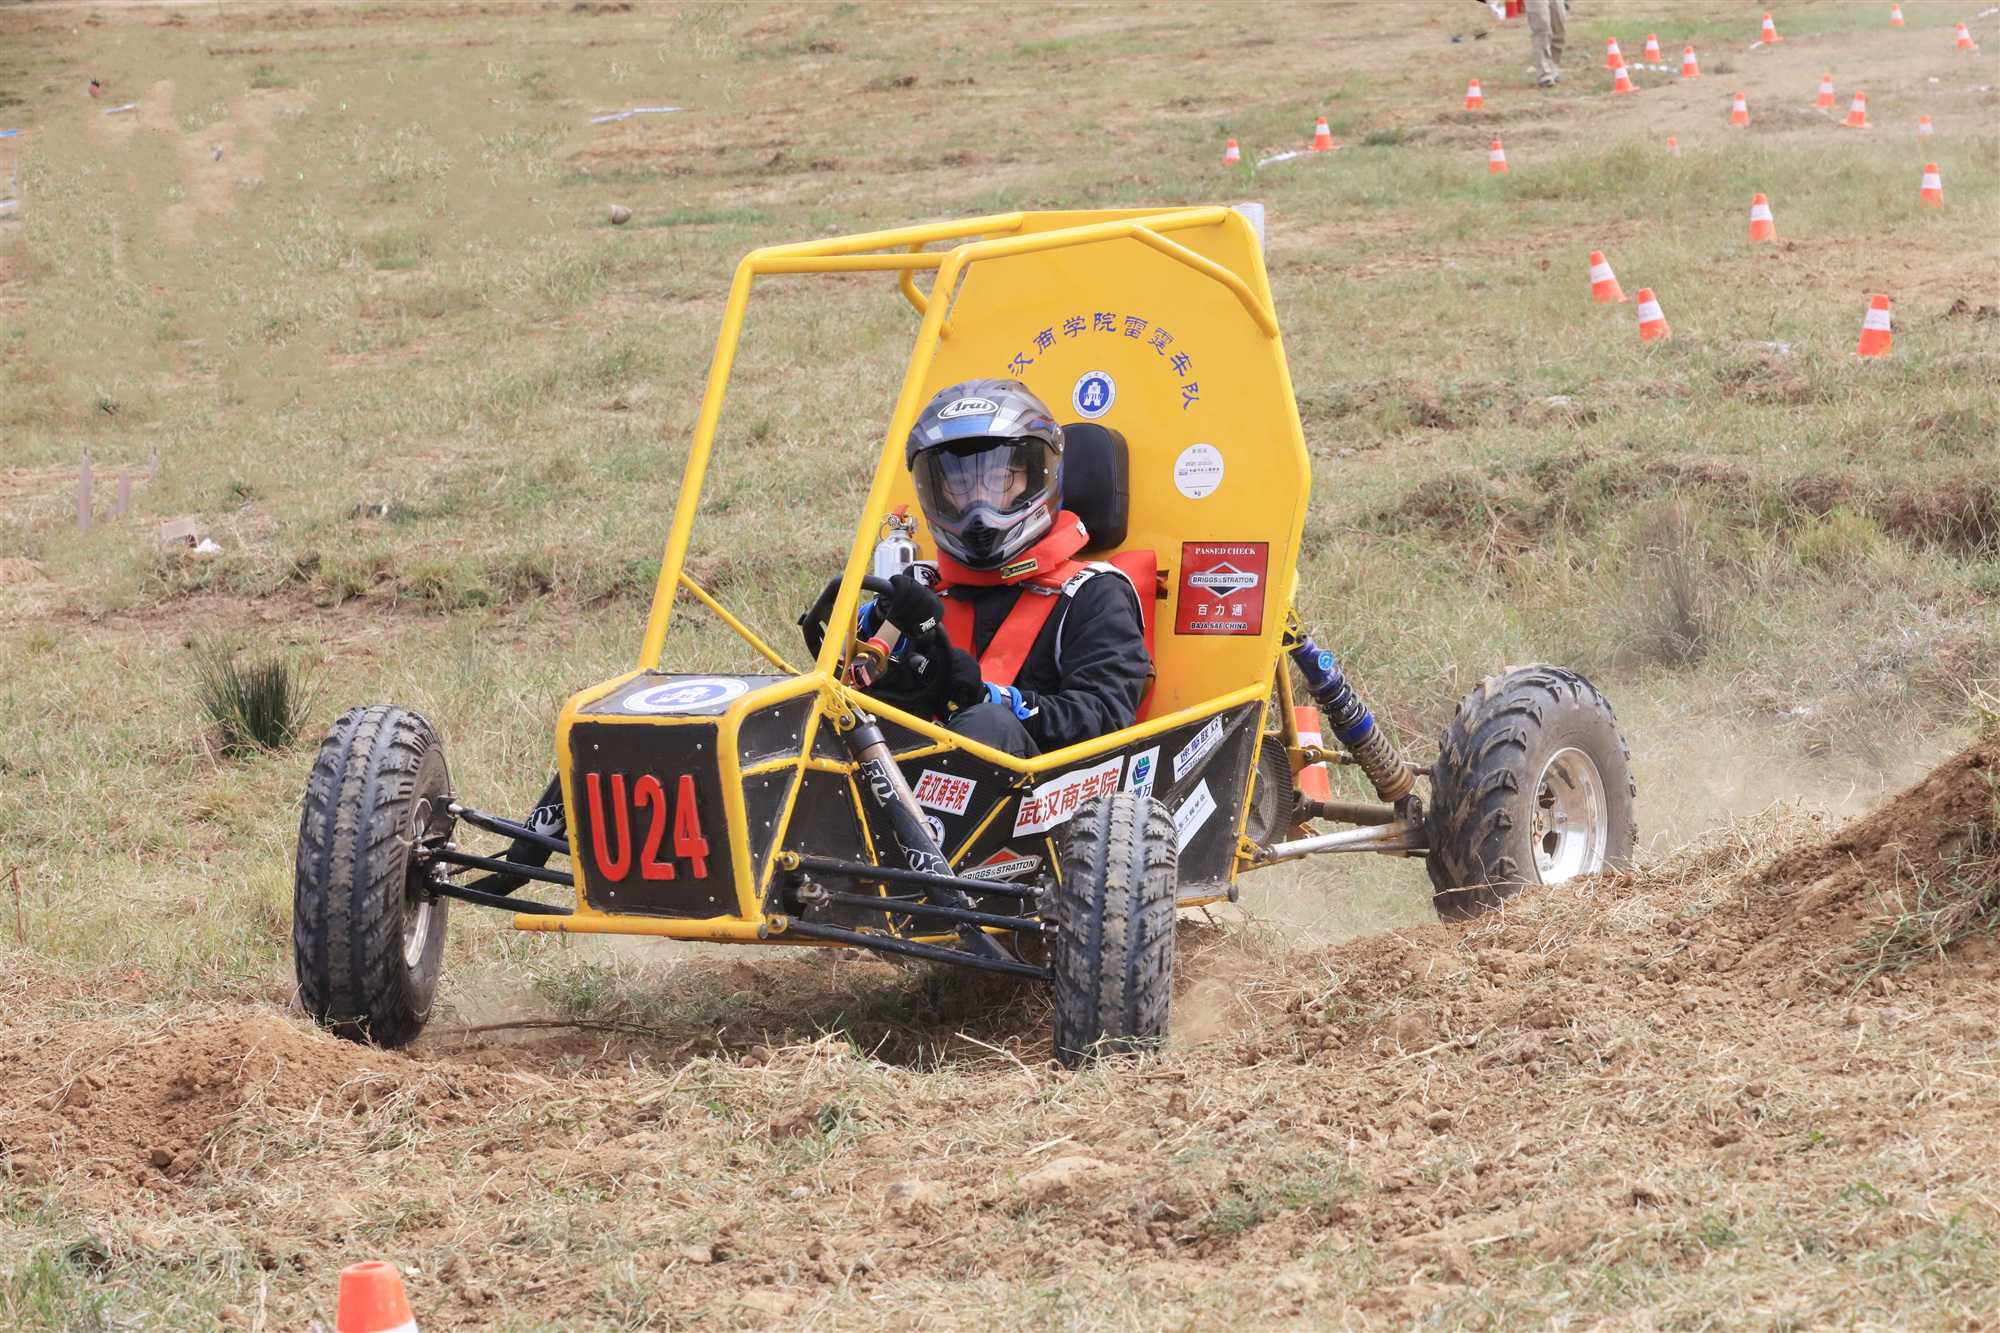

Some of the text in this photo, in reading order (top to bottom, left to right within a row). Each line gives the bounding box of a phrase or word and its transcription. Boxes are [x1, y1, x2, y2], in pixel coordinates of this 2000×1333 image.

[943, 401, 989, 416] Arai
[1195, 547, 1226, 555] PASSED
[1192, 576, 1254, 584] BRIGGS&STRATTON
[1197, 603, 1243, 617] 百力通
[1190, 622, 1248, 631] BAJA SAE CHINA
[915, 773, 970, 811] 武汉商学院
[1017, 767, 1120, 827] 武汉商学院
[1129, 781, 1153, 800] 博万
[586, 773, 710, 882] U24
